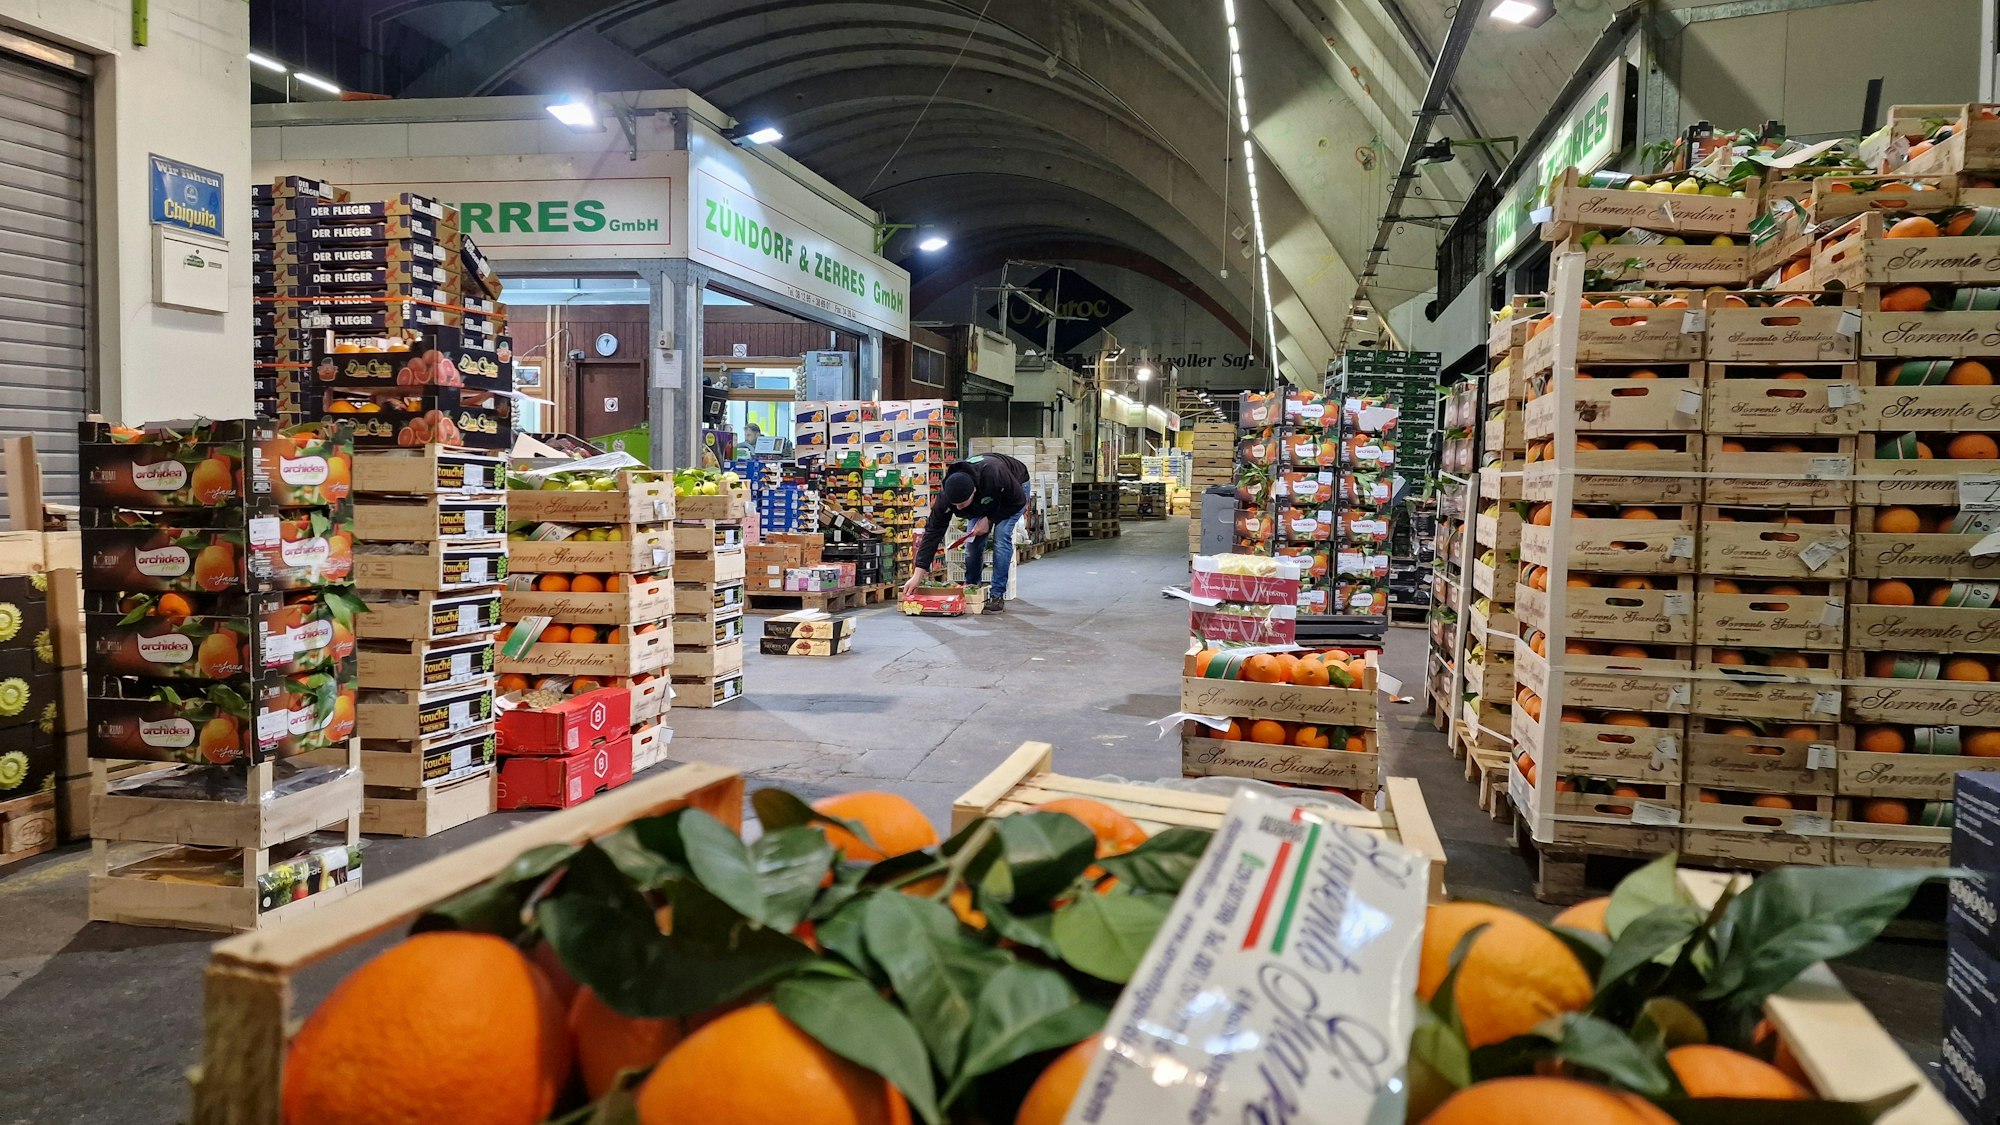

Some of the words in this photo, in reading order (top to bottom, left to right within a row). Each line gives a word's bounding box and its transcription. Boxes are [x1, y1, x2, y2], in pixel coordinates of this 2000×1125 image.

[155, 160, 179, 176] Wir
[181, 167, 219, 187] führen
[311, 206, 329, 216] DER
[333, 205, 371, 216] FLIEGER
[1578, 196, 1646, 216] Sorrento
[164, 198, 216, 229] Chiquita
[447, 200, 607, 233] RRES
[609, 219, 659, 232] GmbH
[312, 229, 331, 238] DER
[333, 227, 372, 238] FLIEGER
[313, 251, 332, 261] DER
[334, 250, 373, 261] FLIEGER
[705, 197, 794, 264] ZÜNDORF
[799, 245, 810, 273] &
[815, 252, 866, 297] ZERRES
[873, 280, 904, 314] GmbH
[1887, 247, 1982, 270] Sorrento
[1657, 253, 1734, 273] Giardini
[313, 273, 332, 283] DER
[334, 273, 373, 282] FLIEGER
[313, 317, 332, 325] DER
[334, 316, 372, 325] FLIEGER
[1579, 329, 1627, 342] Sorrento
[1728, 331, 1777, 344] Sorrento
[1782, 330, 1834, 344] Giardini
[1882, 322, 1979, 345] Sorrento
[1731, 401, 1781, 415] Sorrento
[1785, 401, 1838, 415] Giardini
[1881, 395, 1974, 418] Sorrento
[135, 468, 183, 479] orchidea
[282, 463, 325, 474] orchidea
[438, 466, 464, 477] touché
[544, 497, 601, 515] Giardini
[440, 514, 465, 524] touché
[548, 547, 606, 566] Giardini
[1721, 544, 1771, 557] Sorrento
[1876, 543, 1970, 565] Sorrento
[138, 553, 185, 565] orchidea
[443, 561, 469, 573] touché
[500, 597, 547, 614] Sorrento
[548, 598, 606, 617] Giardini
[432, 611, 459, 625] touché
[1571, 610, 1618, 622] Sorrento
[1623, 611, 1671, 625] Giardini
[1715, 616, 1766, 629] Sorrento
[1867, 615, 1964, 638] Sorrento
[293, 627, 329, 641] rchidea
[141, 641, 189, 651] orchidea
[549, 650, 608, 667] Giardini
[425, 659, 451, 674] touché
[1570, 677, 1617, 691] Sorrento
[1714, 686, 1760, 699] Sorrento
[1861, 688, 1957, 711] Sorrento
[1197, 687, 1269, 709] Sorrento
[1270, 692, 1348, 715] Giardini
[290, 712, 319, 725] orchi
[420, 709, 449, 724] touché
[143, 725, 190, 735] orchidea
[1564, 745, 1610, 759] Sorrento
[424, 754, 451, 769] touché
[1198, 747, 1268, 769] Sorrento
[1270, 755, 1346, 777] Giardini
[1856, 762, 1951, 785] Sorrento
[1296, 822, 1414, 977] Sorrento
